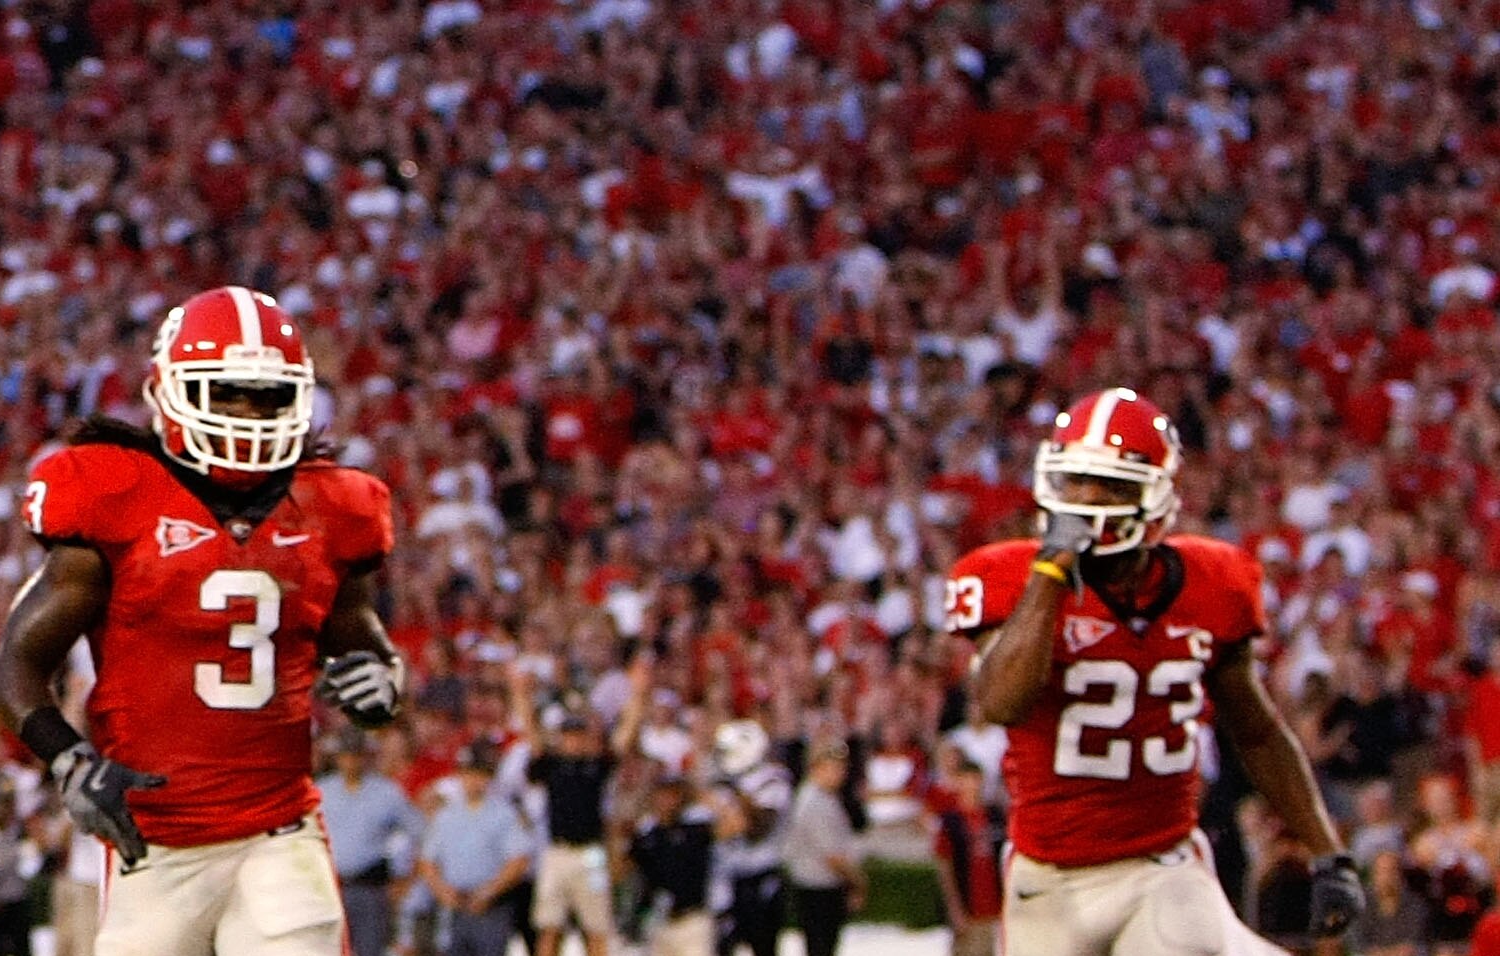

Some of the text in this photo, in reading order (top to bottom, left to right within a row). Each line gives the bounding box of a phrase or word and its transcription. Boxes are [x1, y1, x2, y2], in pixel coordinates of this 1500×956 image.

[194, 569, 281, 710] 3
[1187, 629, 1214, 661] C
[1053, 659, 1206, 780] 23
